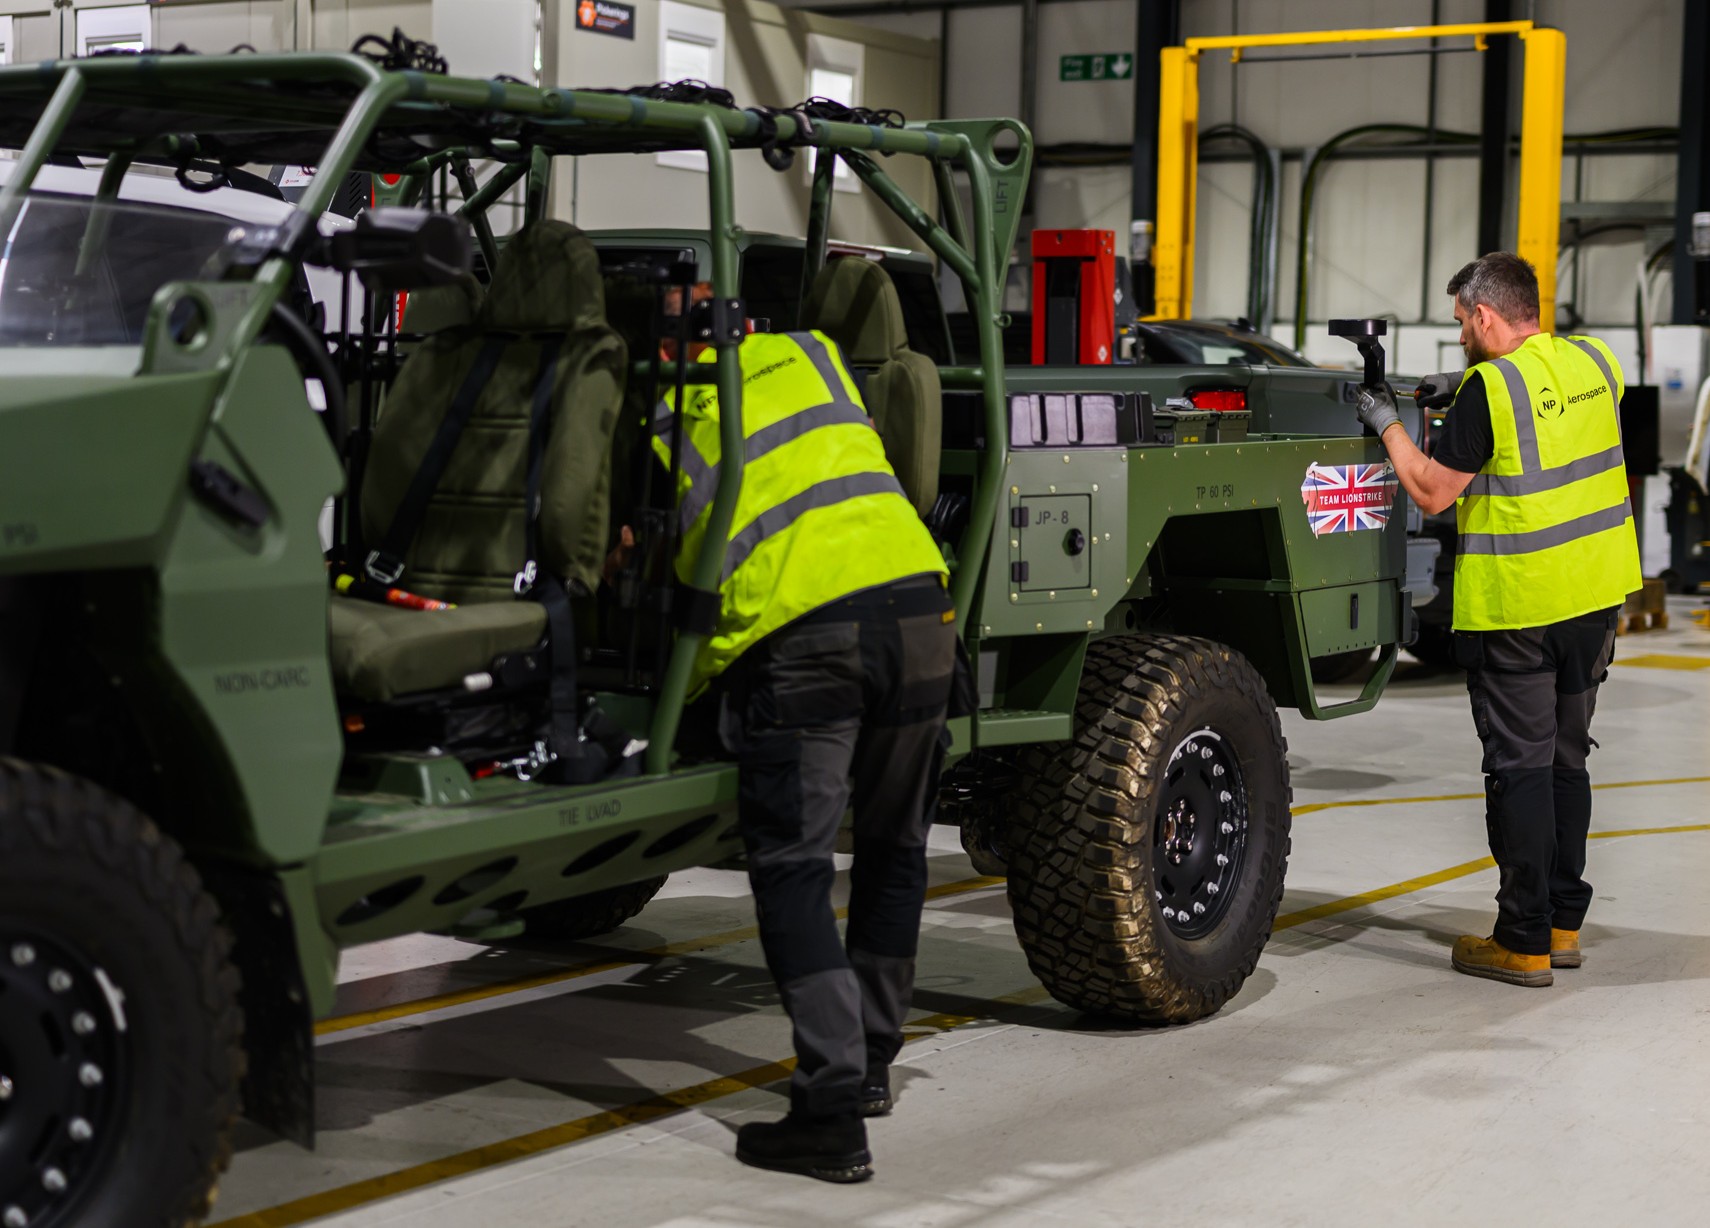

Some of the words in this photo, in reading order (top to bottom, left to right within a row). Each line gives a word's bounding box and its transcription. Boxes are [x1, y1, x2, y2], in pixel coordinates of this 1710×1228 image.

[994, 180, 1009, 214] LIFT
[1542, 400, 1556, 411] NP
[1567, 385, 1607, 405] Aerospace
[1196, 486, 1206, 500] TP
[1210, 484, 1219, 498] 60
[1222, 484, 1234, 498] PSI
[1319, 495, 1340, 506] TEAM
[1341, 491, 1382, 504] LIONSTRIKE
[559, 806, 580, 826] TIE
